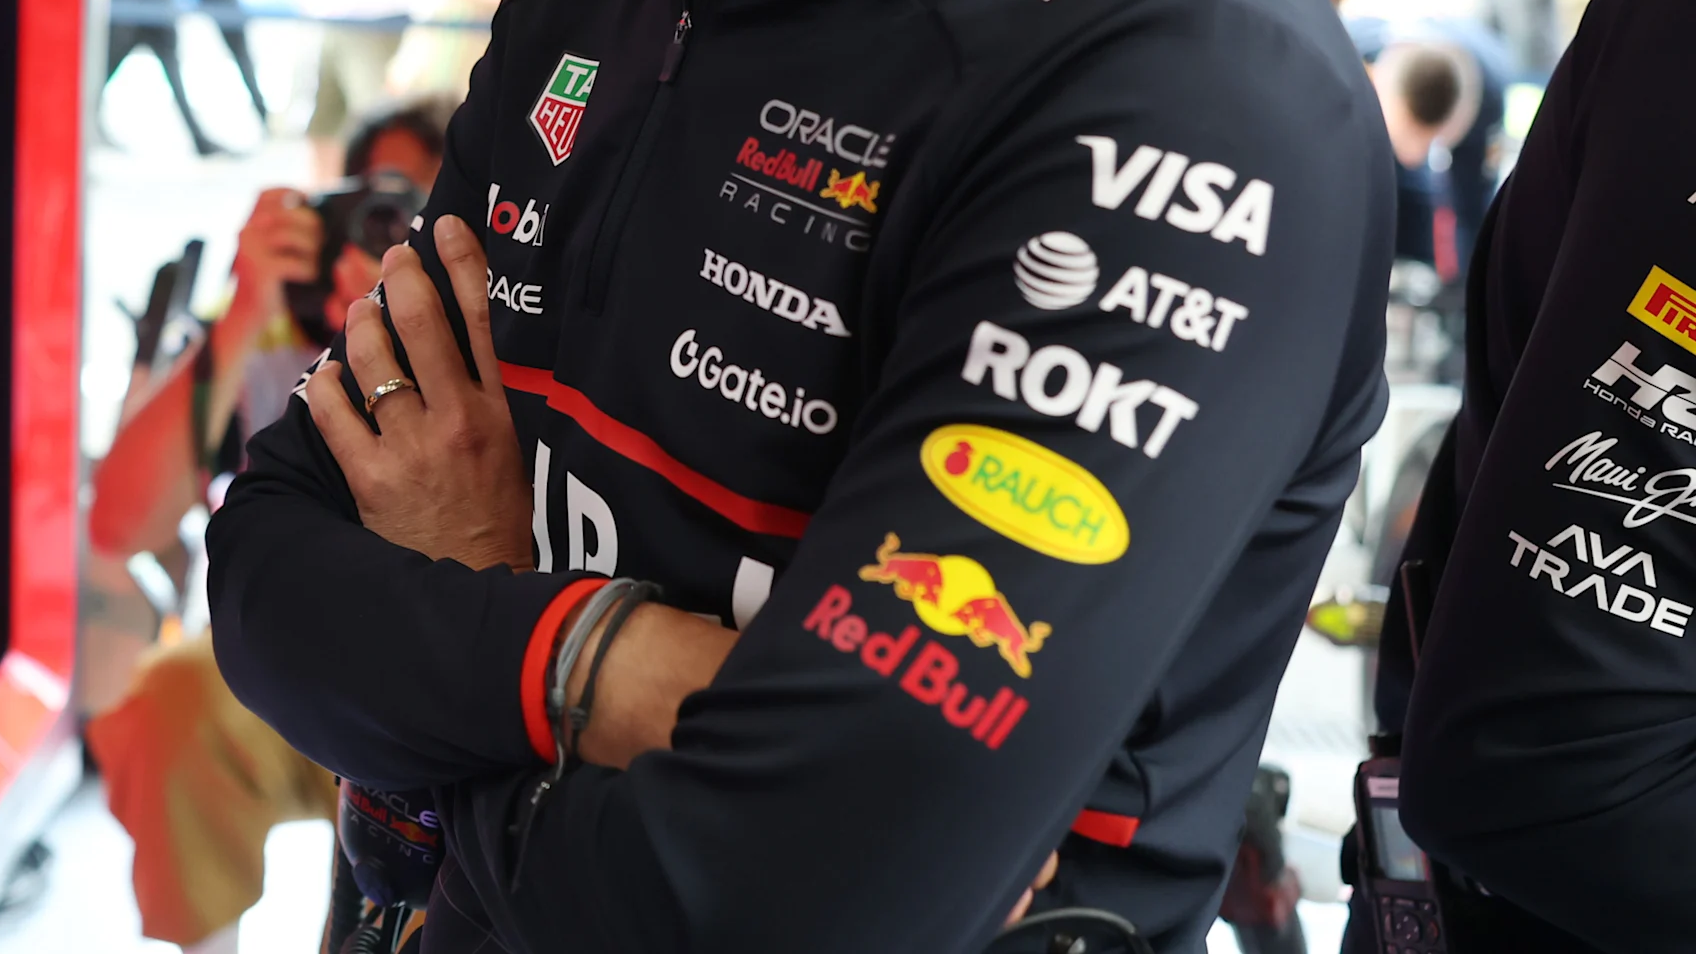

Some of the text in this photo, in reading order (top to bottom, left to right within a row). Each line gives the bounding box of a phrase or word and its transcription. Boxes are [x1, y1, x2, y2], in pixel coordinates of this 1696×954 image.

[564, 64, 598, 97] TA
[539, 101, 584, 156] HEU
[736, 136, 824, 193] Red Bull
[719, 180, 872, 252] RACING
[1074, 135, 1274, 256] VISA
[700, 247, 852, 338] HONDA
[1098, 265, 1249, 352] AT&T
[697, 344, 838, 435] Gate.io
[961, 319, 1199, 460] ROKT
[1583, 378, 1696, 448] Honda RA
[971, 454, 1108, 548] RAUCH
[1544, 431, 1646, 491] Maui
[1506, 531, 1694, 638] TRADE
[1546, 524, 1657, 588] AVA
[804, 583, 918, 679] Red
[899, 640, 1030, 751] Bull
